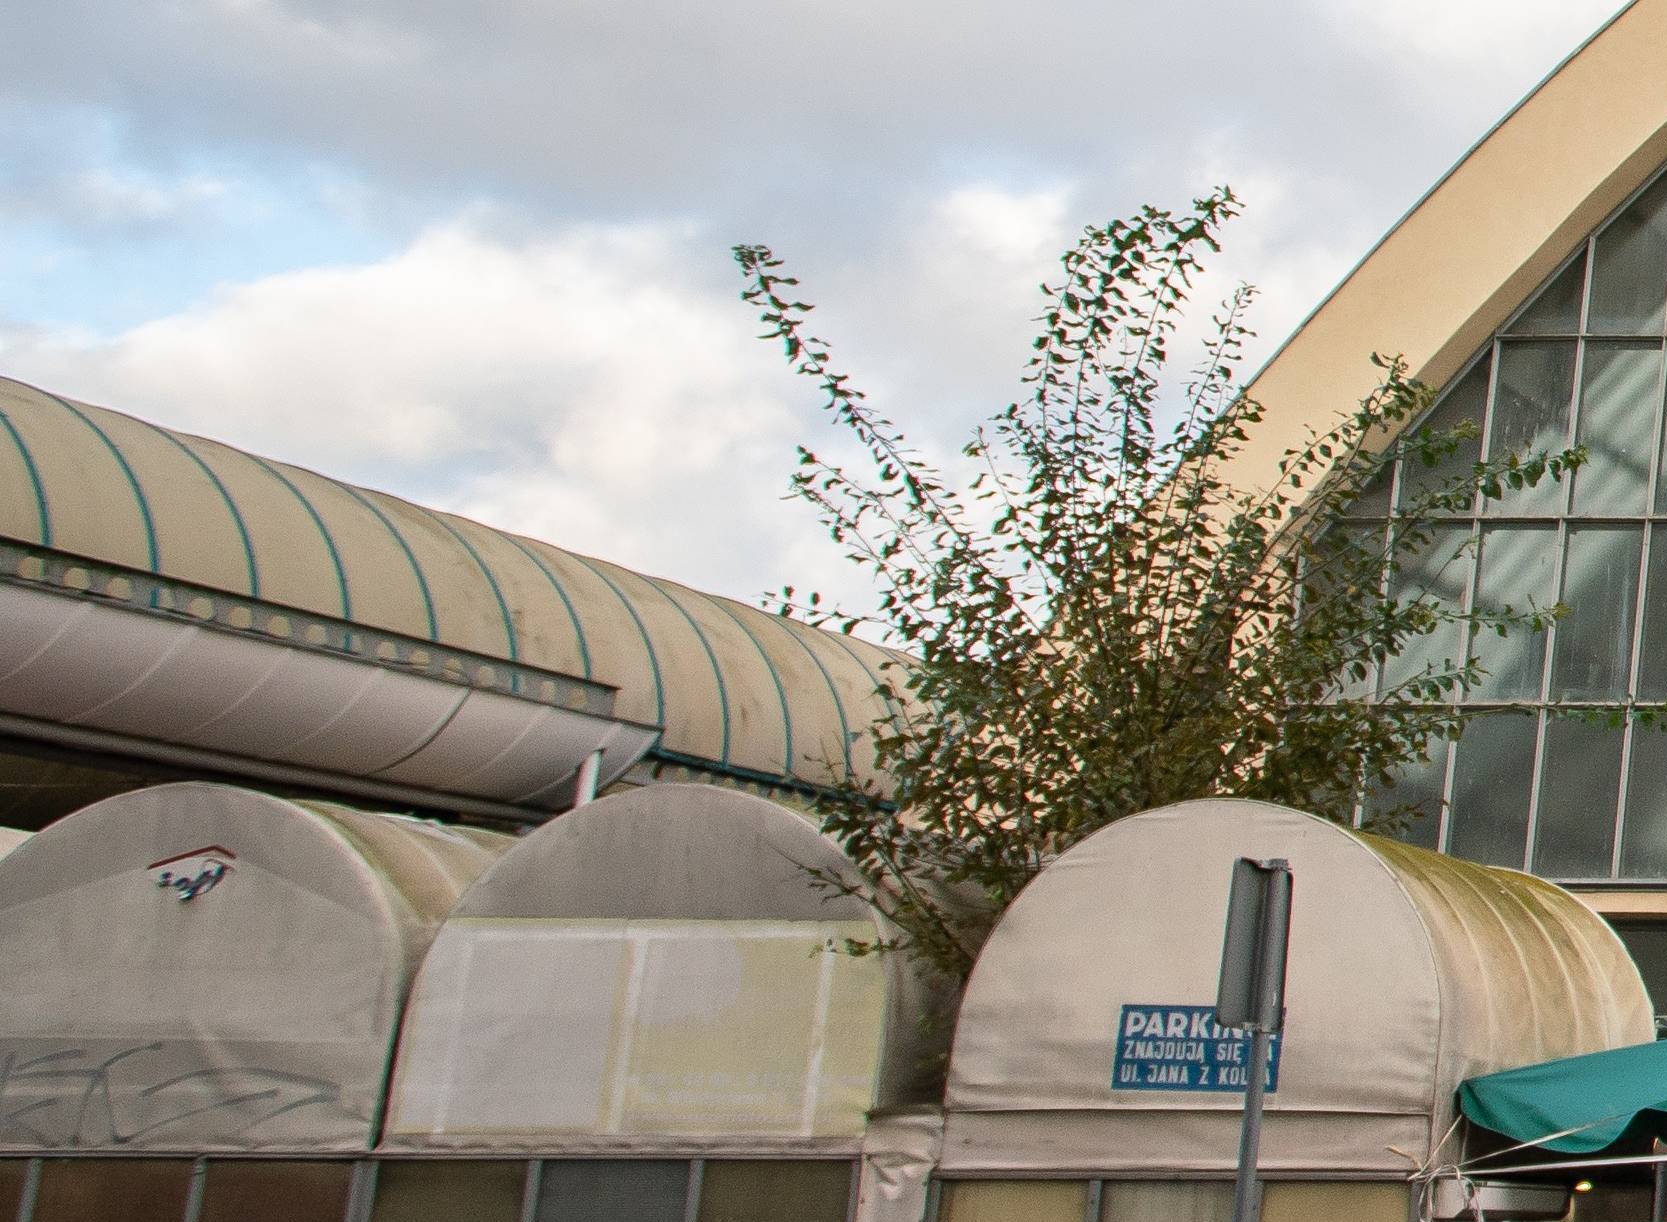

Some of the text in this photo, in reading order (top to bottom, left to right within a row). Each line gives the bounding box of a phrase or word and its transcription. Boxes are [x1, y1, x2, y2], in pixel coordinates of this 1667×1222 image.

[1125, 1011, 1278, 1040] PARK
[1147, 1064, 1189, 1085] JANA
[1198, 1065, 1209, 1085] Z
[1217, 1066, 1271, 1086] KOLA
